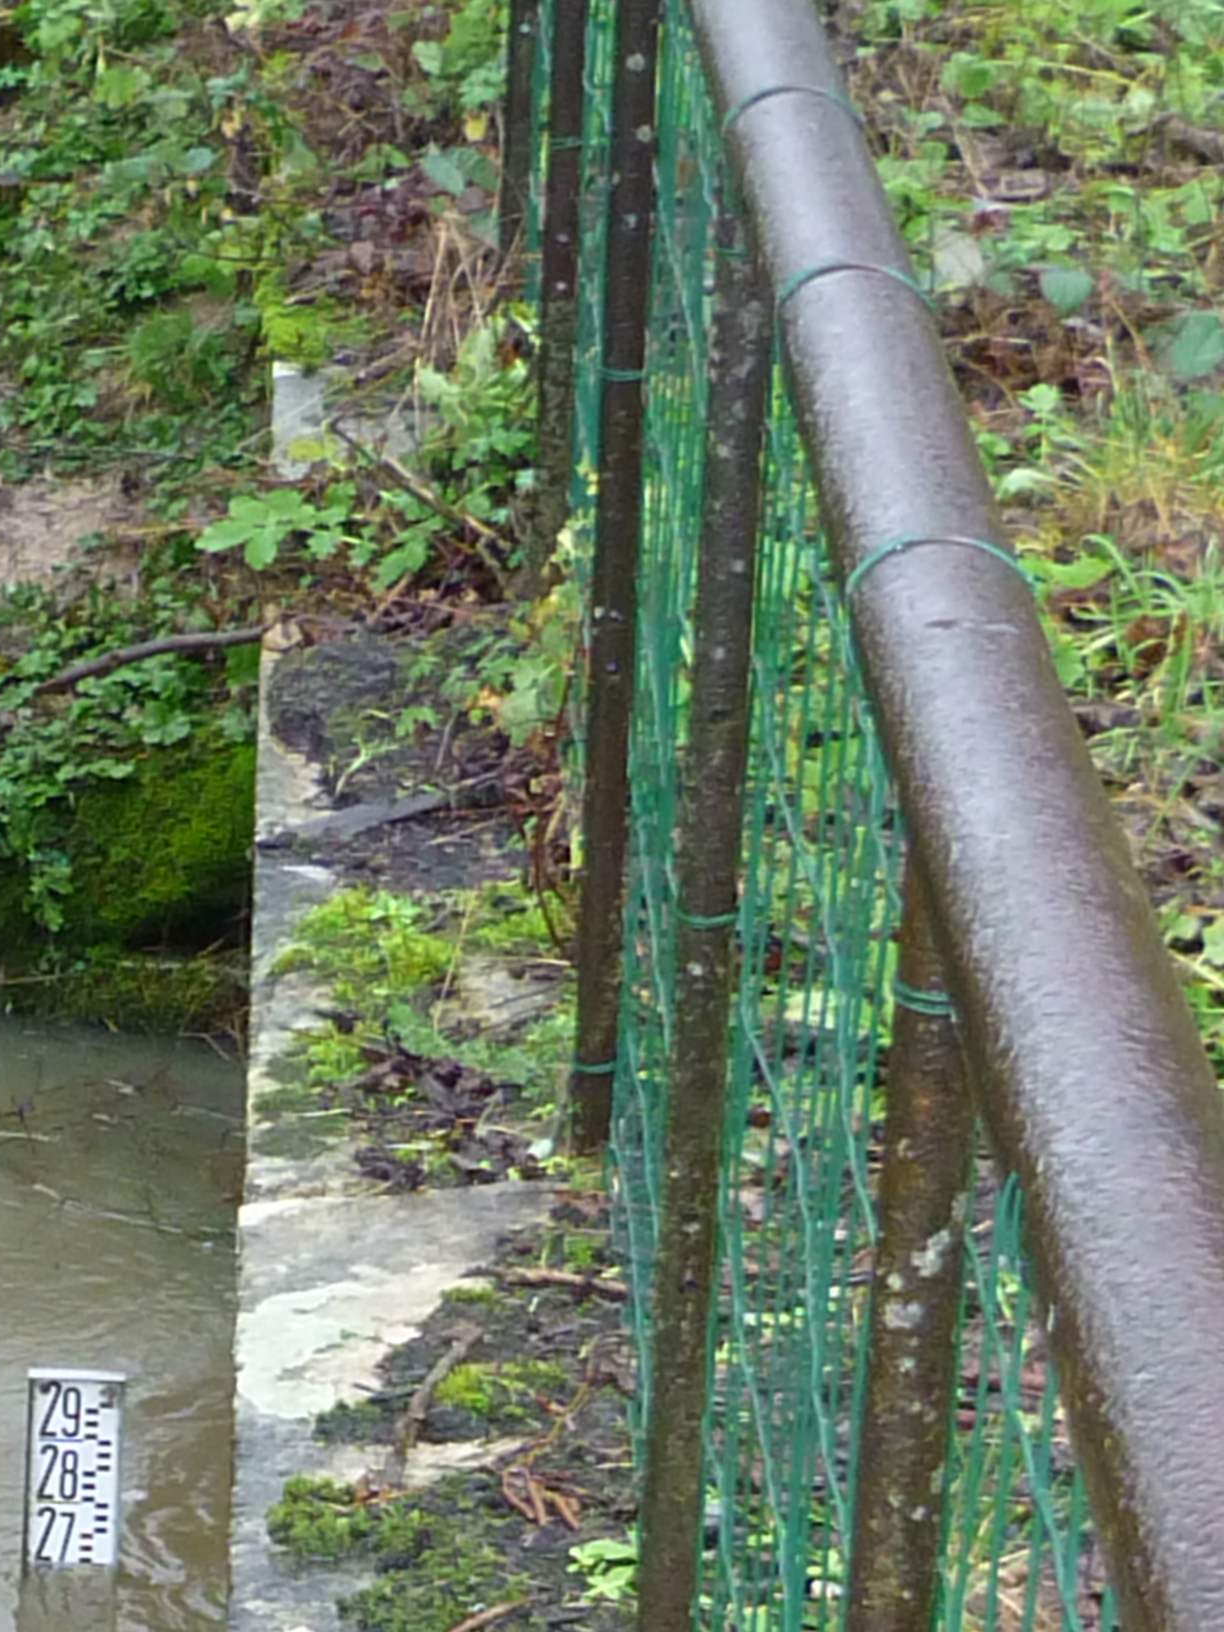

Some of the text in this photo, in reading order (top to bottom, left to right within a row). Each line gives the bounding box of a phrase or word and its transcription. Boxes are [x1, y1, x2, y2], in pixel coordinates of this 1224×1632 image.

[39, 1380, 82, 1438] 29
[36, 1444, 79, 1501] 28
[34, 1506, 76, 1564] 27
